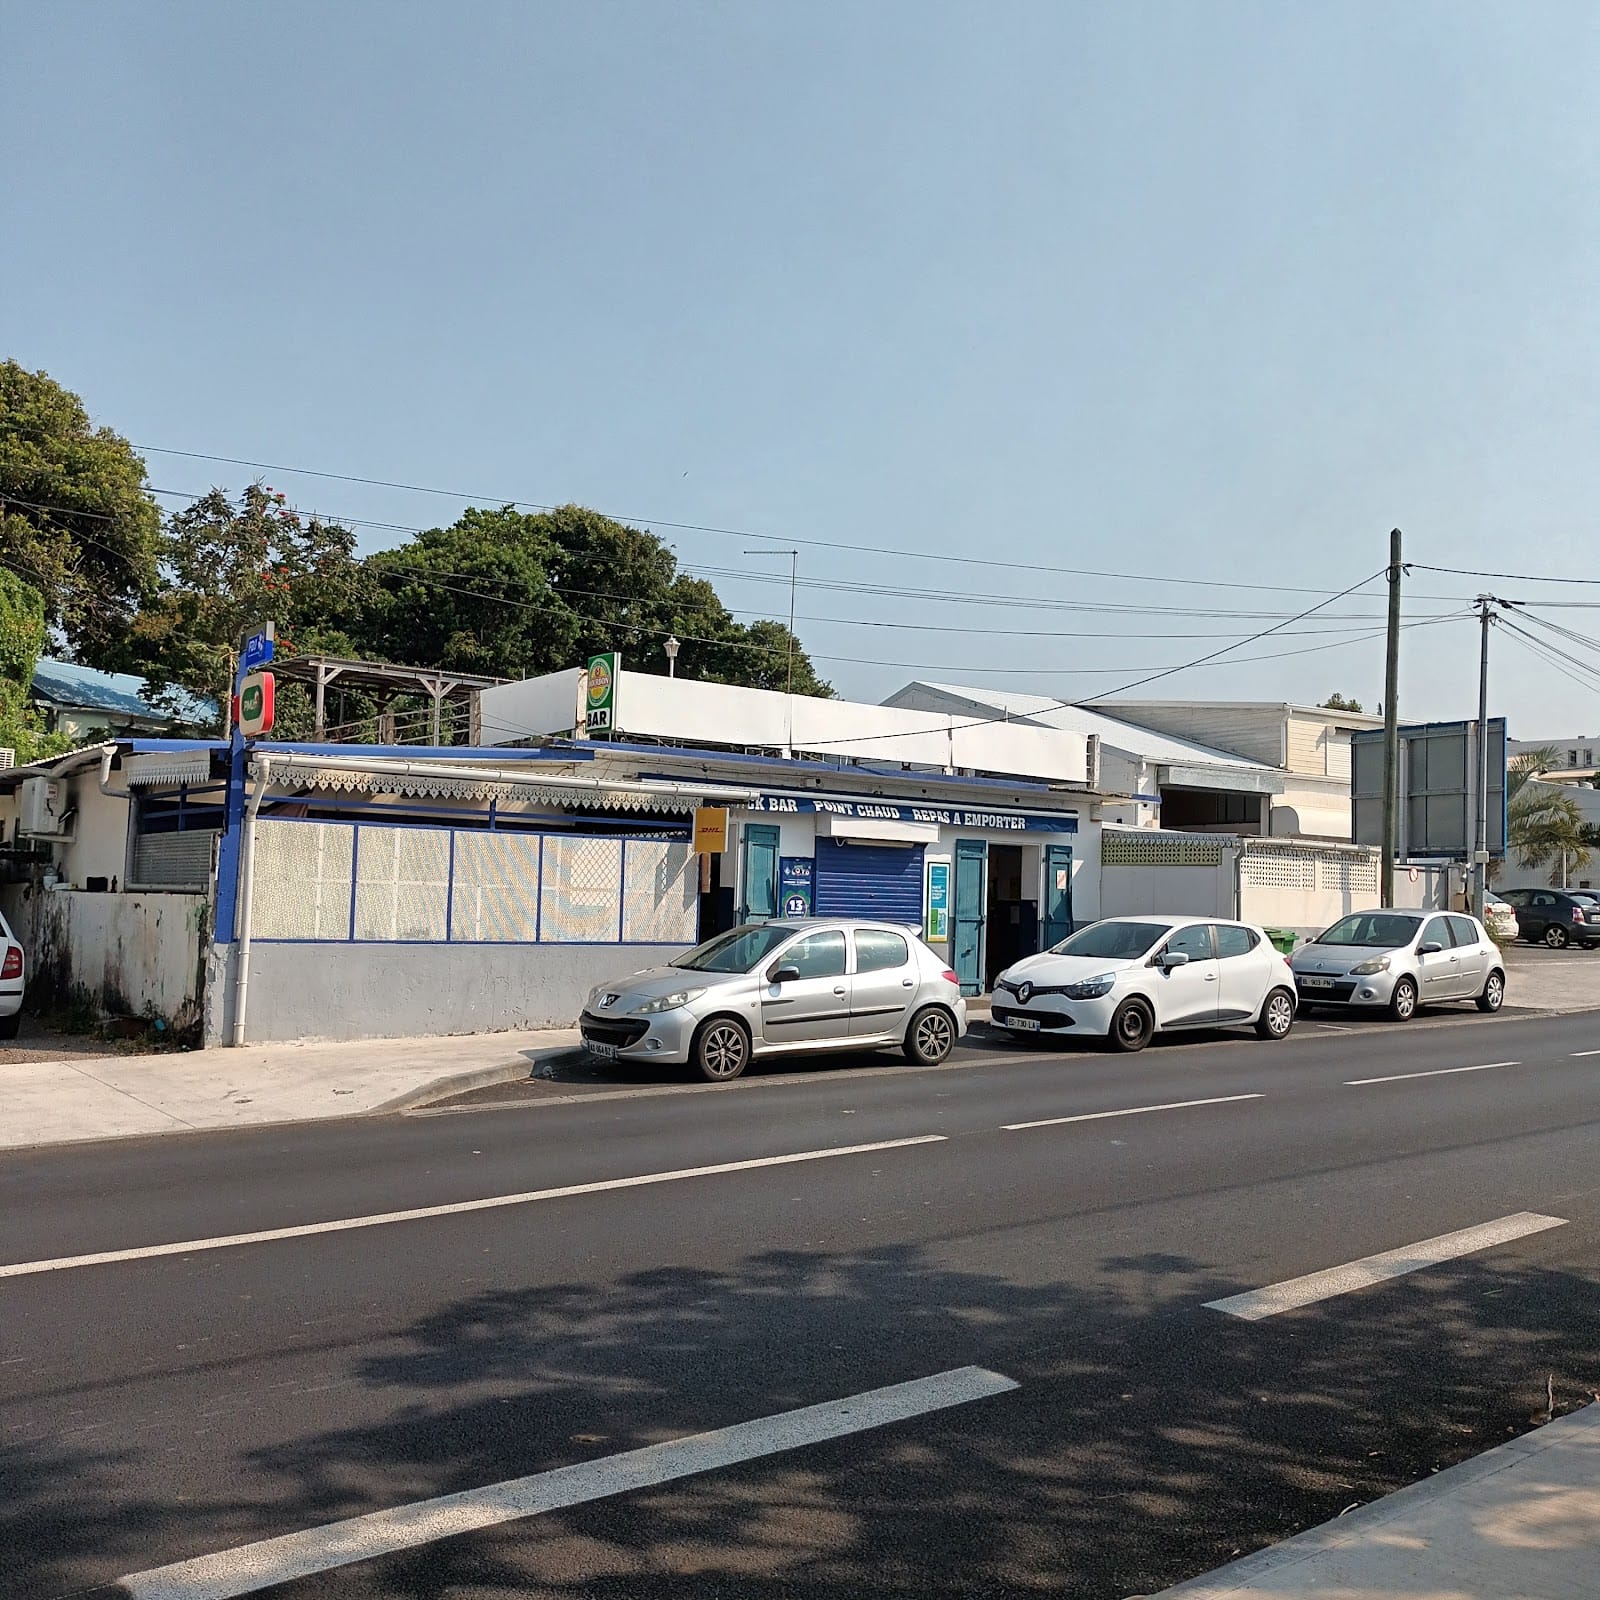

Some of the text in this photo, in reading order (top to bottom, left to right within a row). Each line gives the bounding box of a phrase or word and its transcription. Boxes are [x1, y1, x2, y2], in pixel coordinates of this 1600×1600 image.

[587, 711, 607, 727] BAR
[768, 798, 798, 812] BAR
[813, 800, 853, 815] POINT
[856, 804, 900, 819] CHAUD
[913, 808, 951, 824] REPAS
[953, 811, 962, 825] A
[964, 813, 1026, 829] EMPORTER
[789, 899, 803, 911] 13
